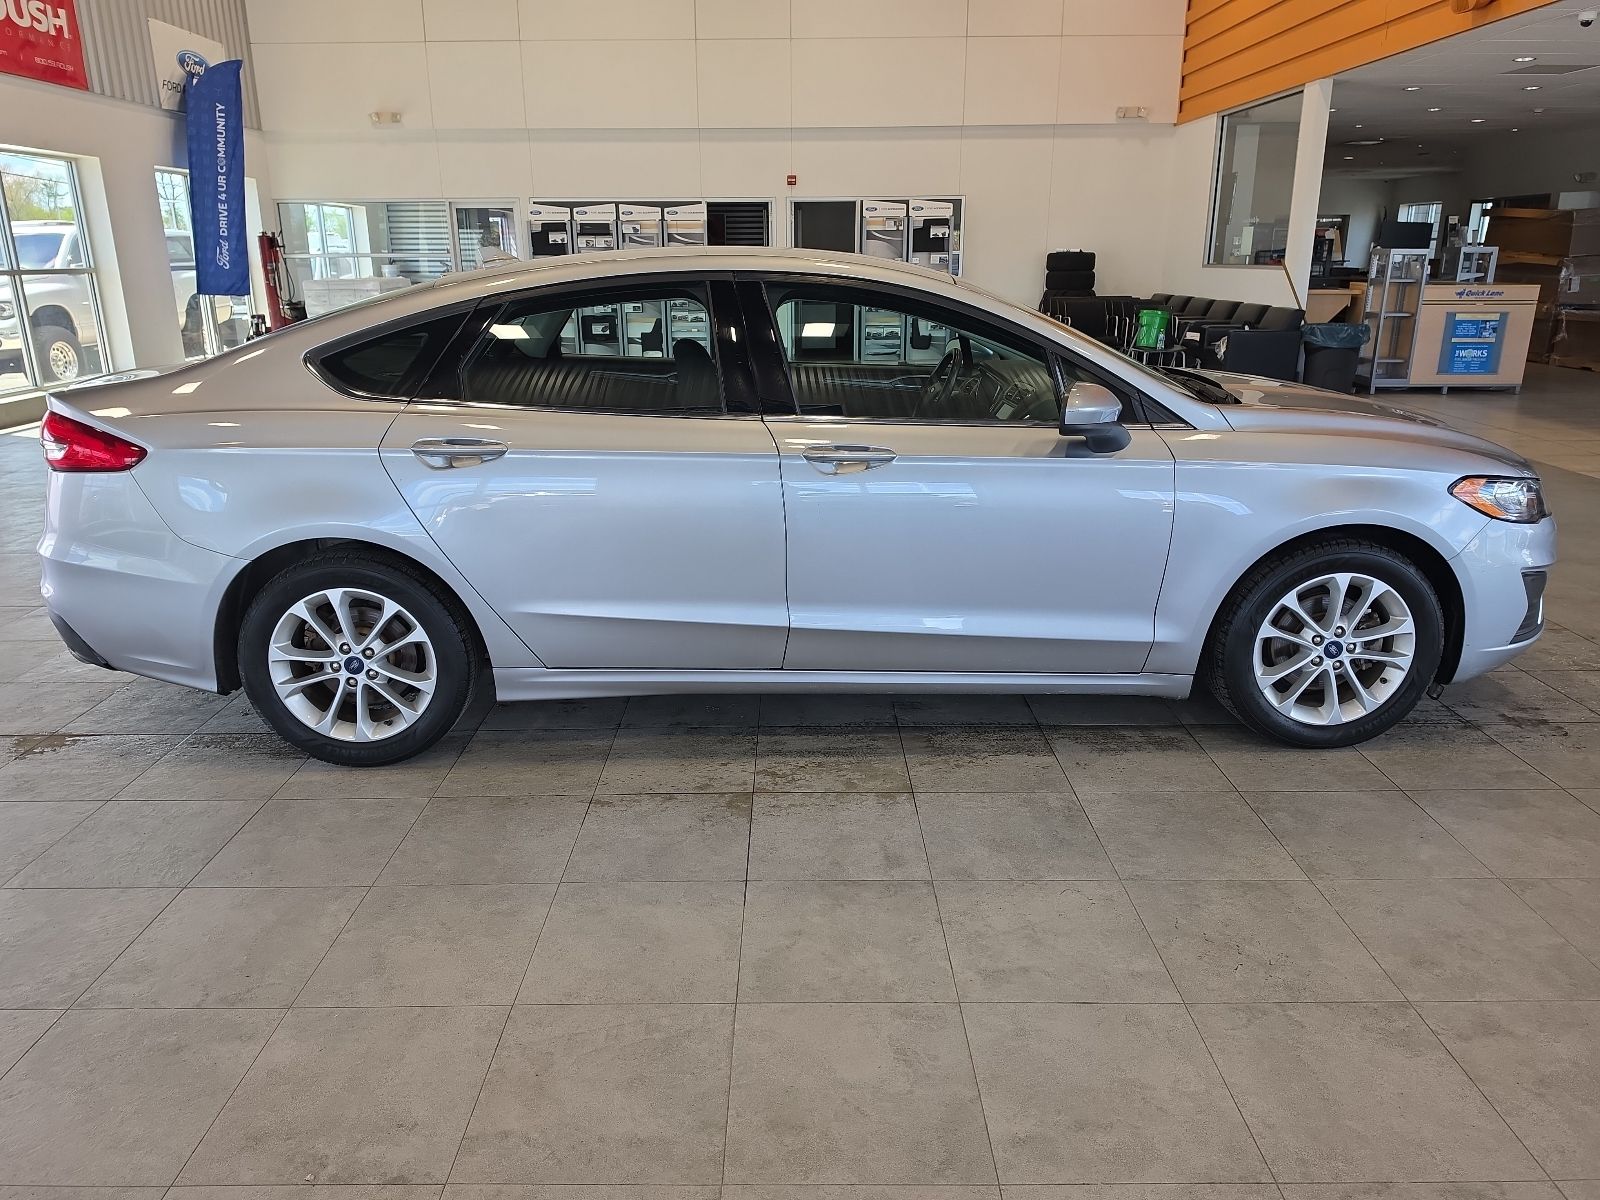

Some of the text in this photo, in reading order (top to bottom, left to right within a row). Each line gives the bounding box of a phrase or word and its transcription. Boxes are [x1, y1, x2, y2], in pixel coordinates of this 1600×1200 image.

[184, 54, 206, 76] Ford
[162, 79, 182, 94] FORD
[217, 175, 227, 191] UR
[217, 192, 227, 201] 4
[217, 203, 228, 236] DRIVE
[216, 240, 230, 270] Ford
[1465, 289, 1505, 297] Quick Lane
